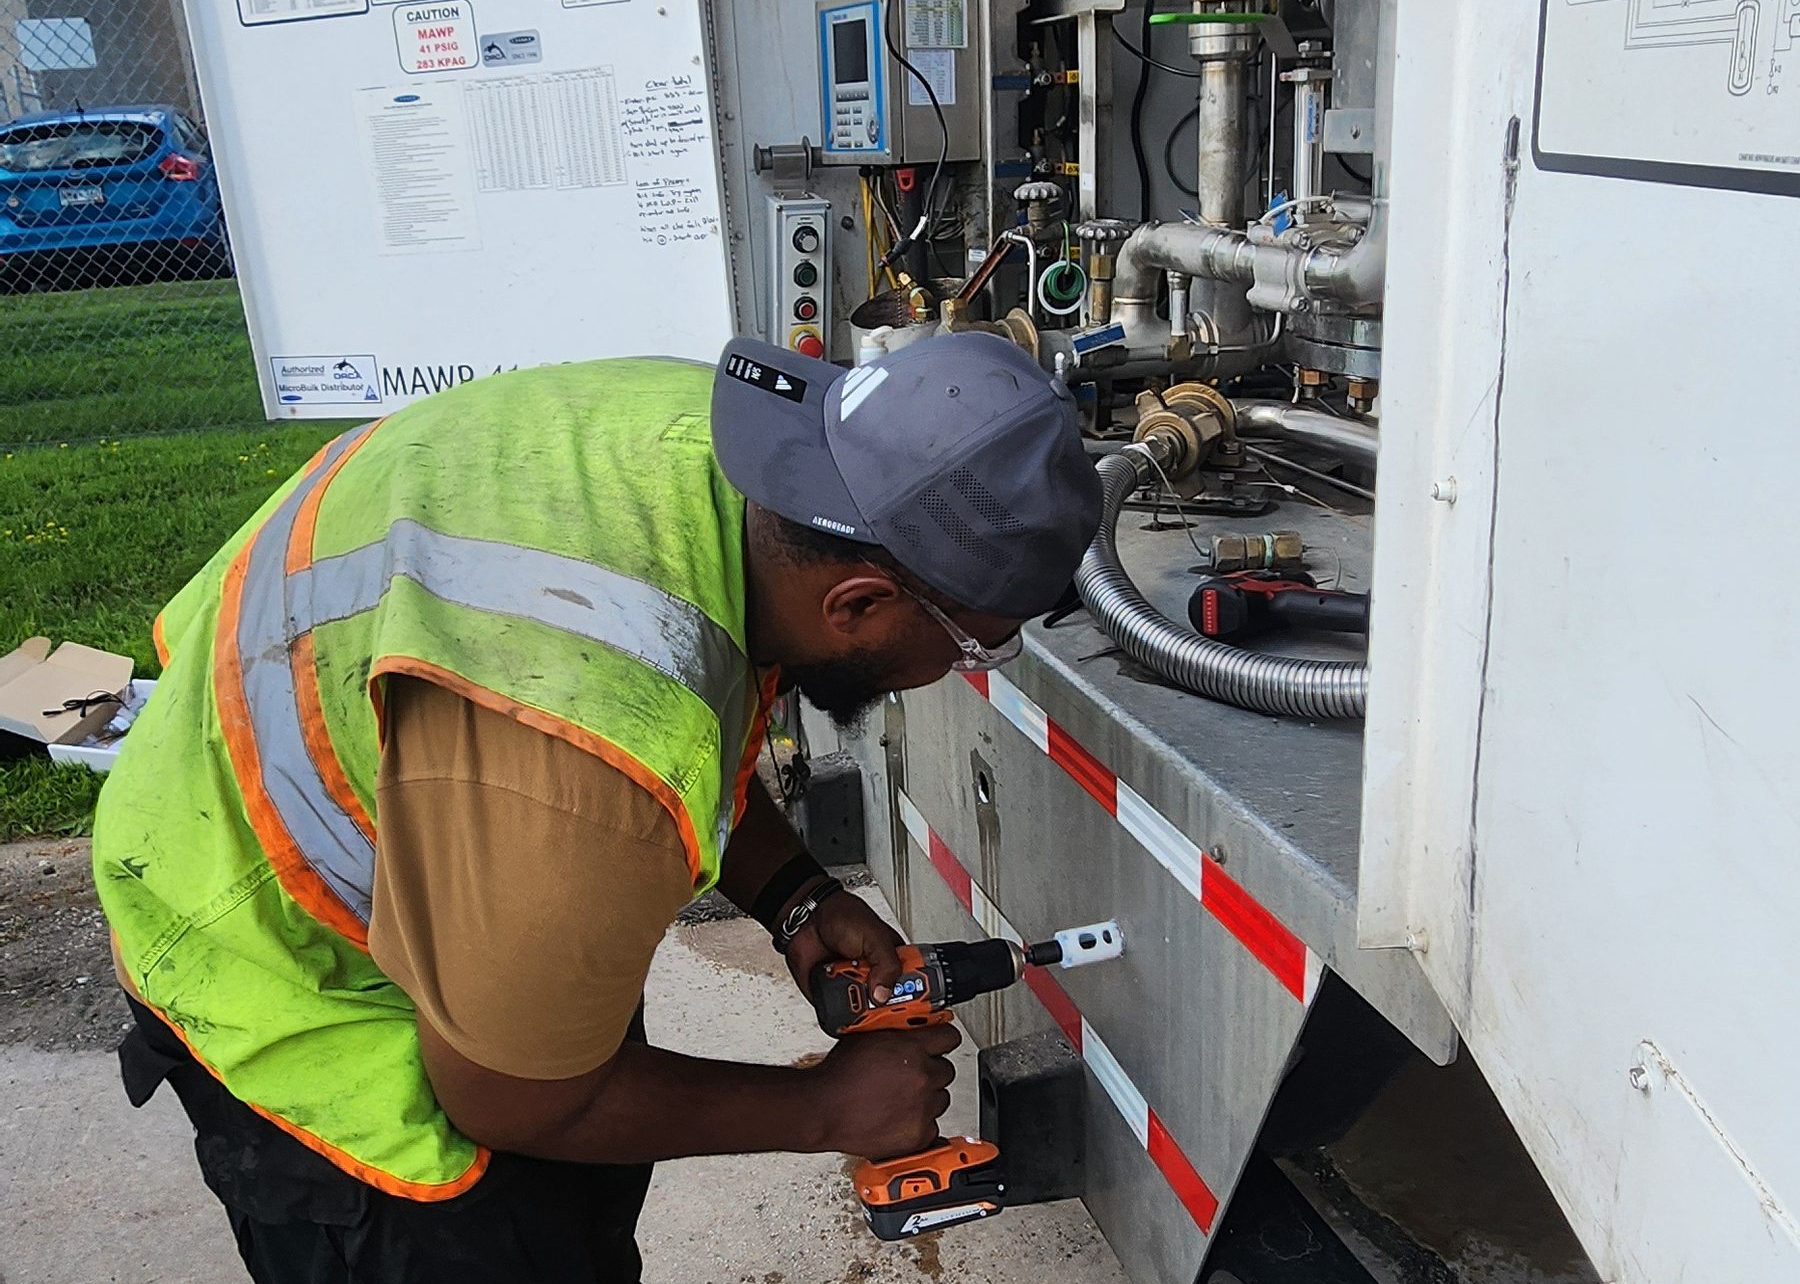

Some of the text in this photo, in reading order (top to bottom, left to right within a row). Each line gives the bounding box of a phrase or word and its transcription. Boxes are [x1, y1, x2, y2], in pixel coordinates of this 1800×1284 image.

[406, 7, 460, 22] CAUTION
[417, 26, 455, 40] MAWP
[419, 41, 459, 54] 41 PSIG
[416, 56, 467, 70] 283 KPAG
[280, 364, 363, 380] Authorized ORCA
[279, 381, 364, 393] MicroBulk Distributor
[383, 364, 474, 396] MAWP
